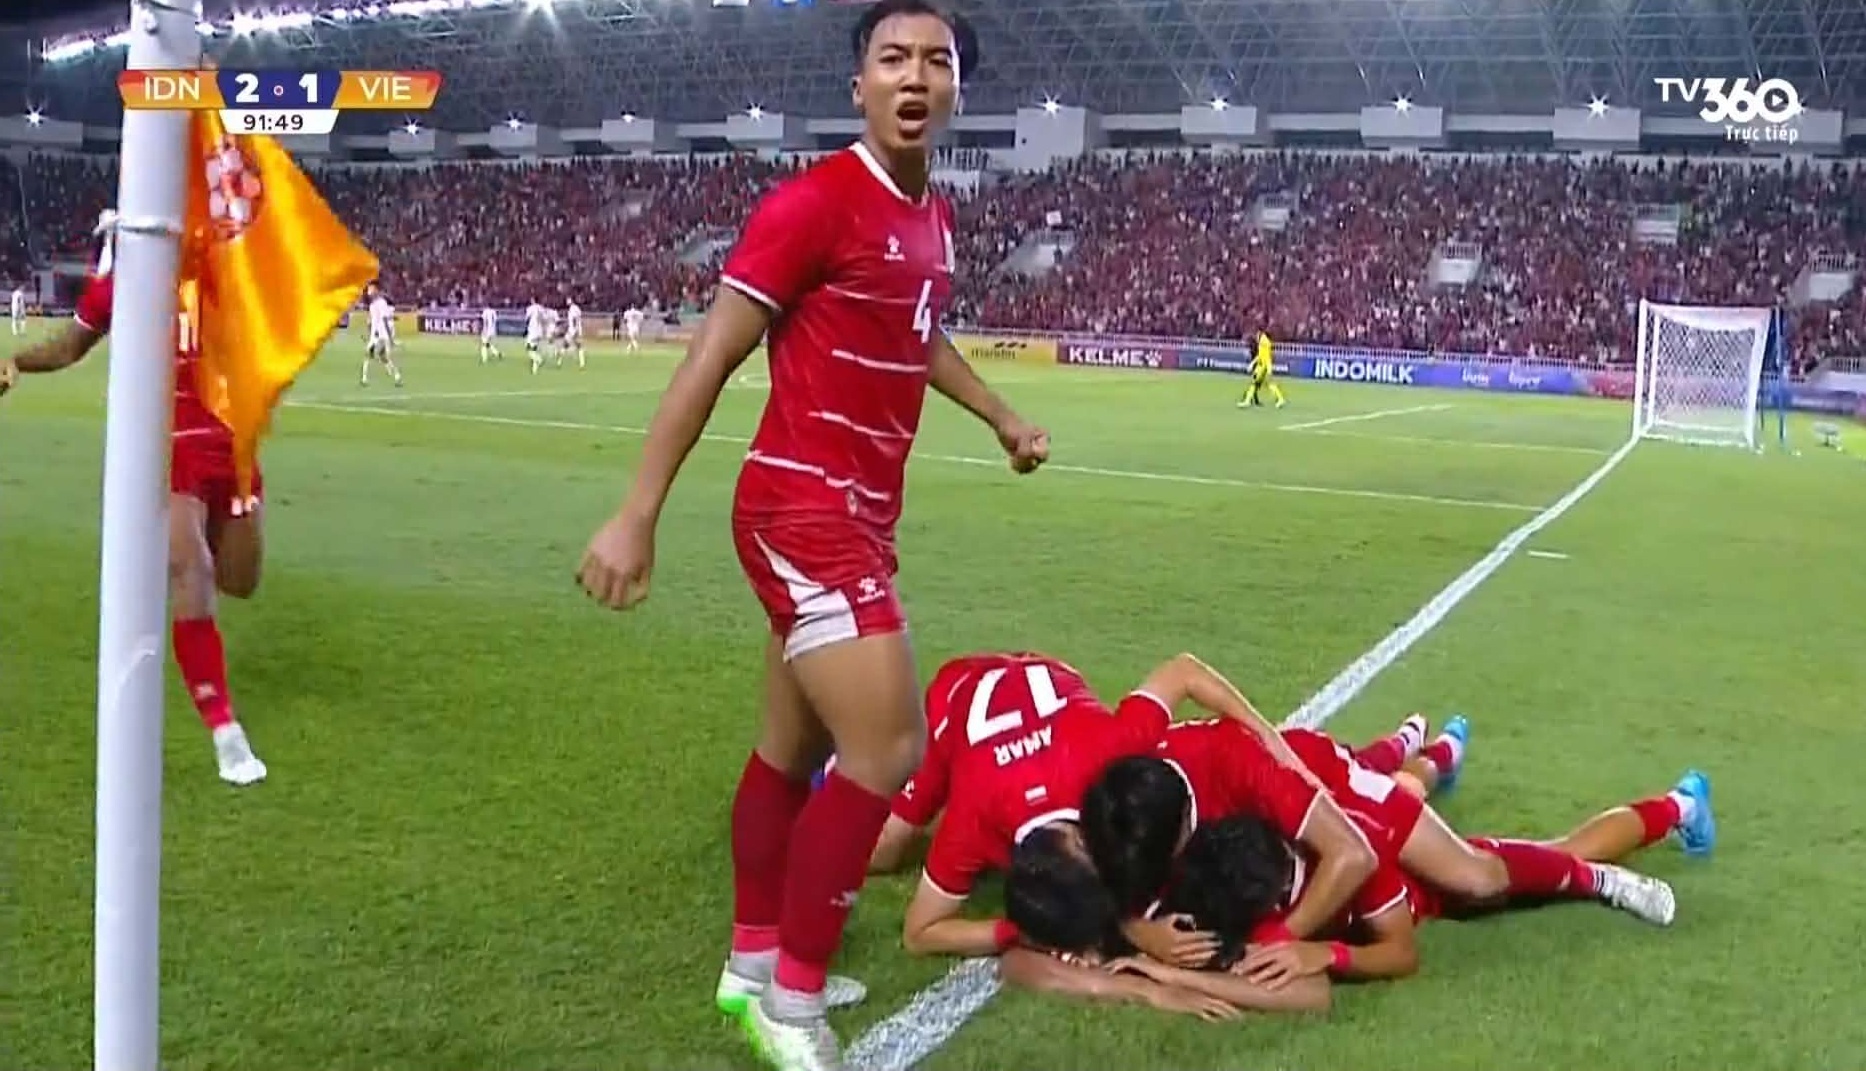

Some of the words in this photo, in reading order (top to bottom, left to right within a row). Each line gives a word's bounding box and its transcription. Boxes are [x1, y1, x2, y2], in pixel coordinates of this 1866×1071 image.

[912, 279, 932, 343] 4
[1068, 346, 1145, 366] KELME
[1314, 358, 1414, 383] INDOMILK
[966, 664, 1068, 747] 17
[993, 724, 1052, 766] AMAR
